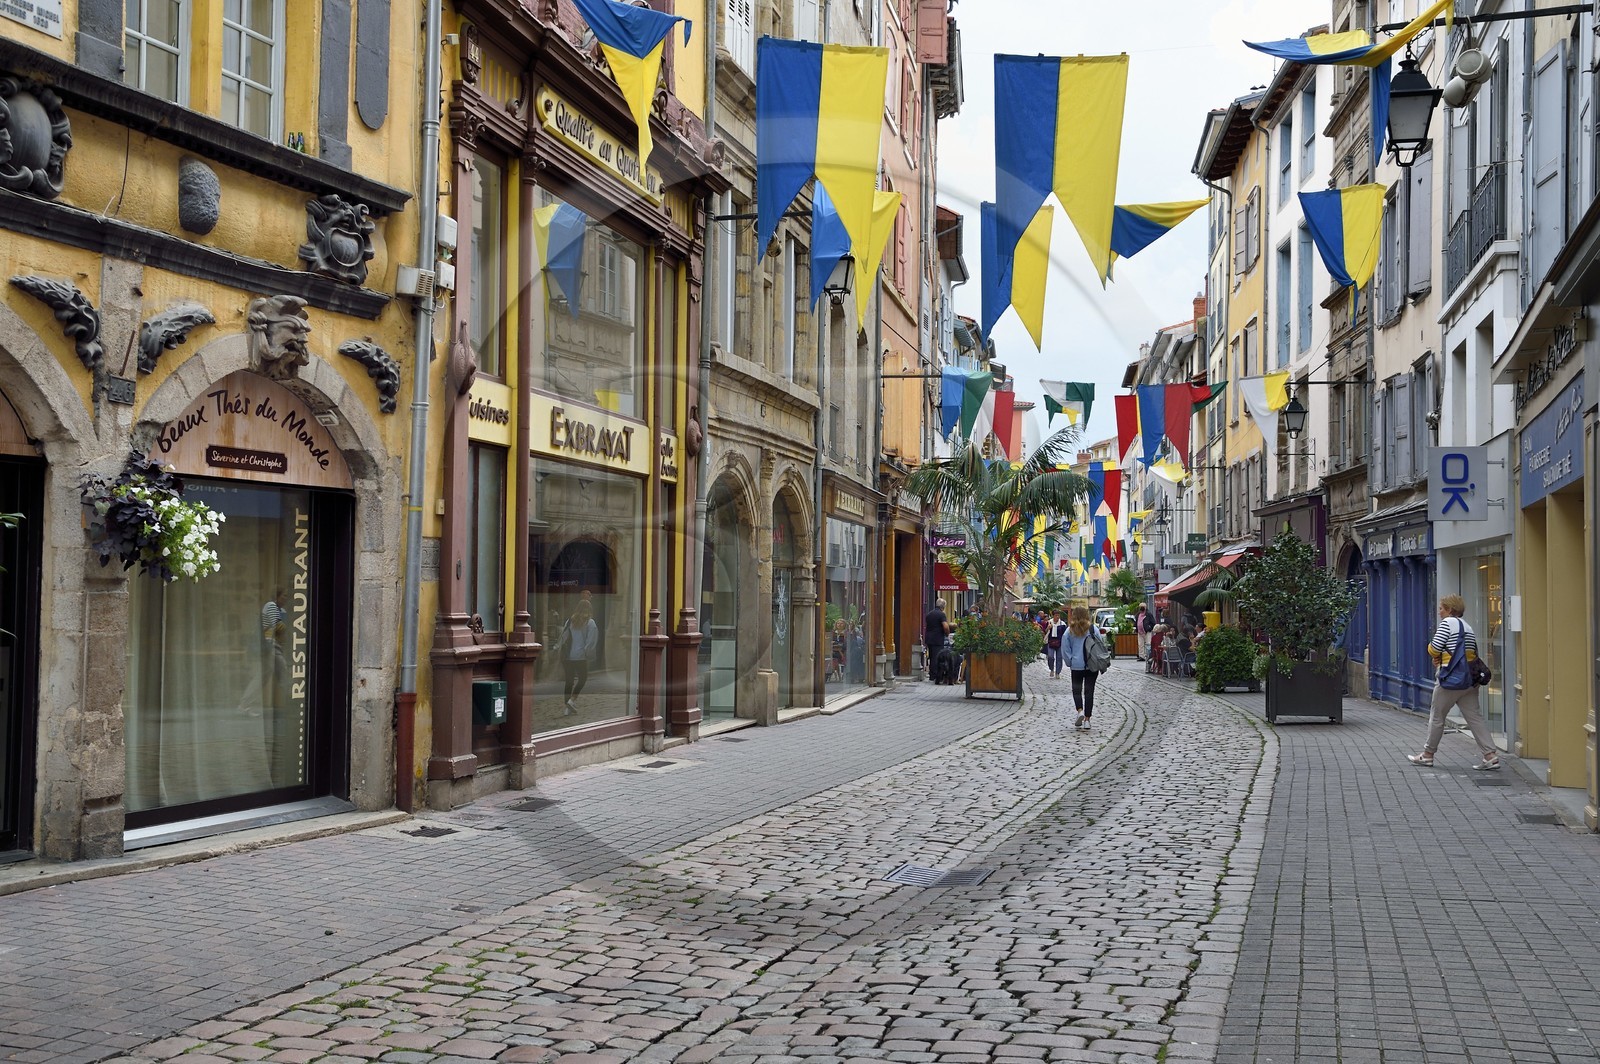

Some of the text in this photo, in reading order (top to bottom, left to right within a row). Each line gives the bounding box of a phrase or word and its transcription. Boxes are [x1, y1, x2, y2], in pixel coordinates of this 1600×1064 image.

[468, 392, 510, 425] uisines
[156, 389, 332, 472] Beaux Thés du Monde
[240, 456, 249, 465] et
[249, 454, 283, 470] Christophe
[660, 437, 674, 458] alle
[291, 507, 309, 700] RESTAURANT
